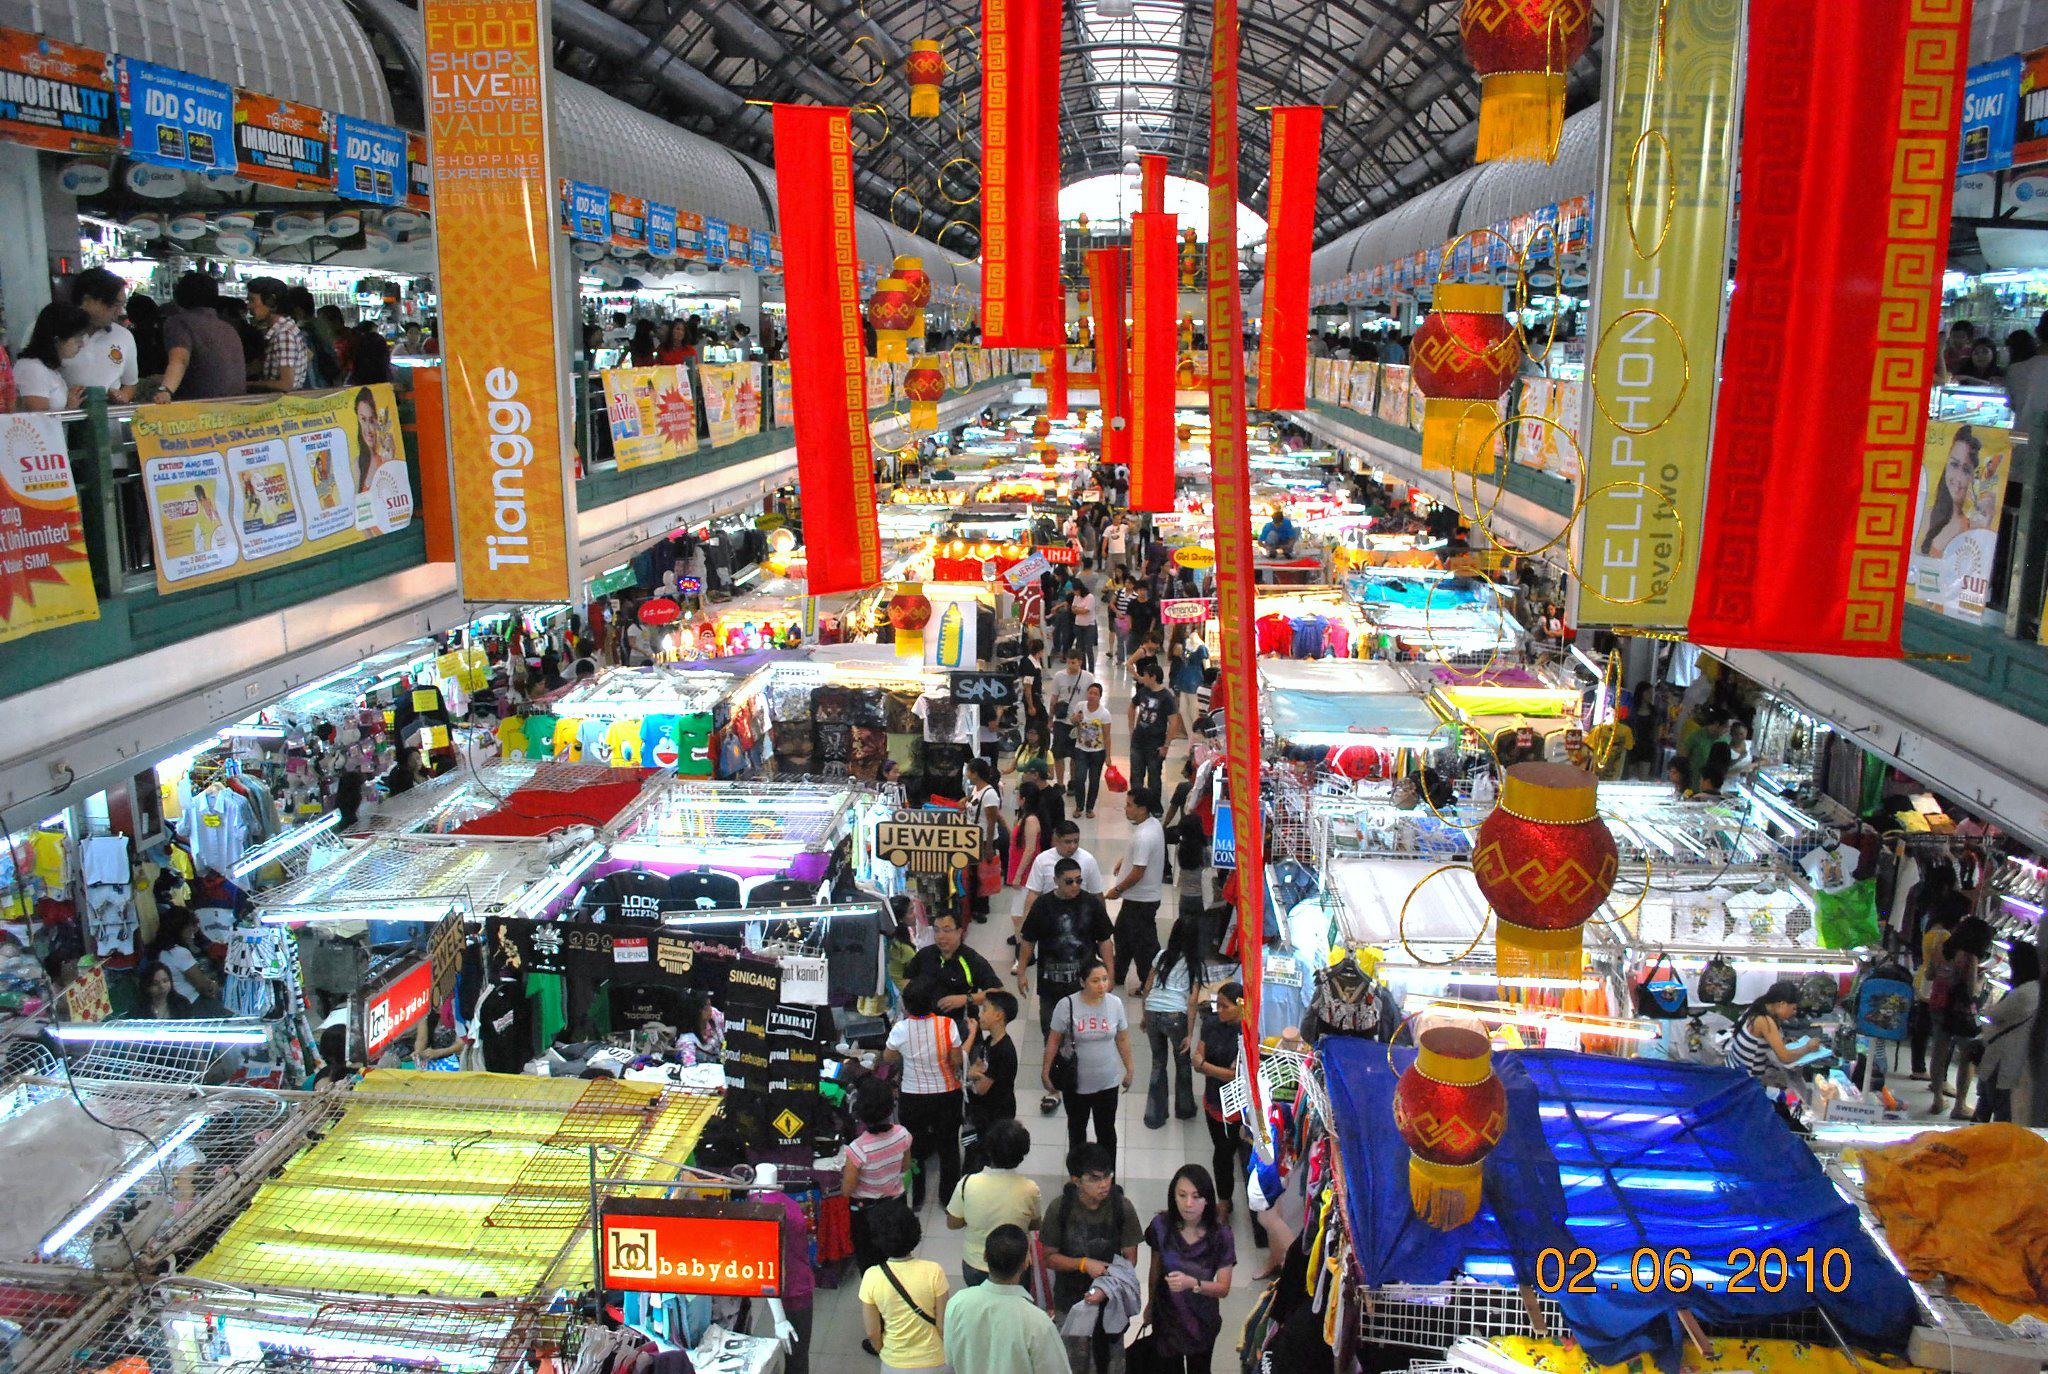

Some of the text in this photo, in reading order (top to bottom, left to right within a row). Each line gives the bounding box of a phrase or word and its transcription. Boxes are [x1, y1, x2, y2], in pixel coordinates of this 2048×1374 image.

[428, 7, 534, 20] GLOBAL
[428, 19, 535, 50] FOOD
[429, 50, 536, 77] SHOP &
[145, 88, 179, 120] IDD
[432, 98, 538, 113] DISCOVER
[432, 112, 540, 138] VALUE
[346, 137, 370, 161] IDD
[436, 138, 538, 154] FAMILY
[436, 154, 540, 167] SHOPPING
[437, 166, 540, 180] EXPERIENCE
[485, 367, 534, 570] Tiangge
[8, 522, 70, 549] Unlimited
[1644, 463, 1679, 604] level two
[25, 551, 51, 571] SIM!
[1018, 557, 1044, 577] JERSEY
[956, 678, 1007, 700] SAND
[895, 811, 967, 825] ONLY IN
[882, 827, 977, 849] JEWELS
[621, 895, 660, 911] 100%
[621, 909, 659, 920] FILIPINO
[617, 950, 647, 959] FILIPINO
[660, 948, 691, 960] Jeepney
[729, 969, 777, 991] SINIGANG
[770, 1012, 813, 1030] TAMBAY
[1078, 1016, 1109, 1032] USA
[769, 1048, 789, 1064] proud
[768, 1078, 787, 1093] proud
[1835, 1104, 1876, 1115] SWEEPER
[659, 1257, 775, 1282] babydoll
